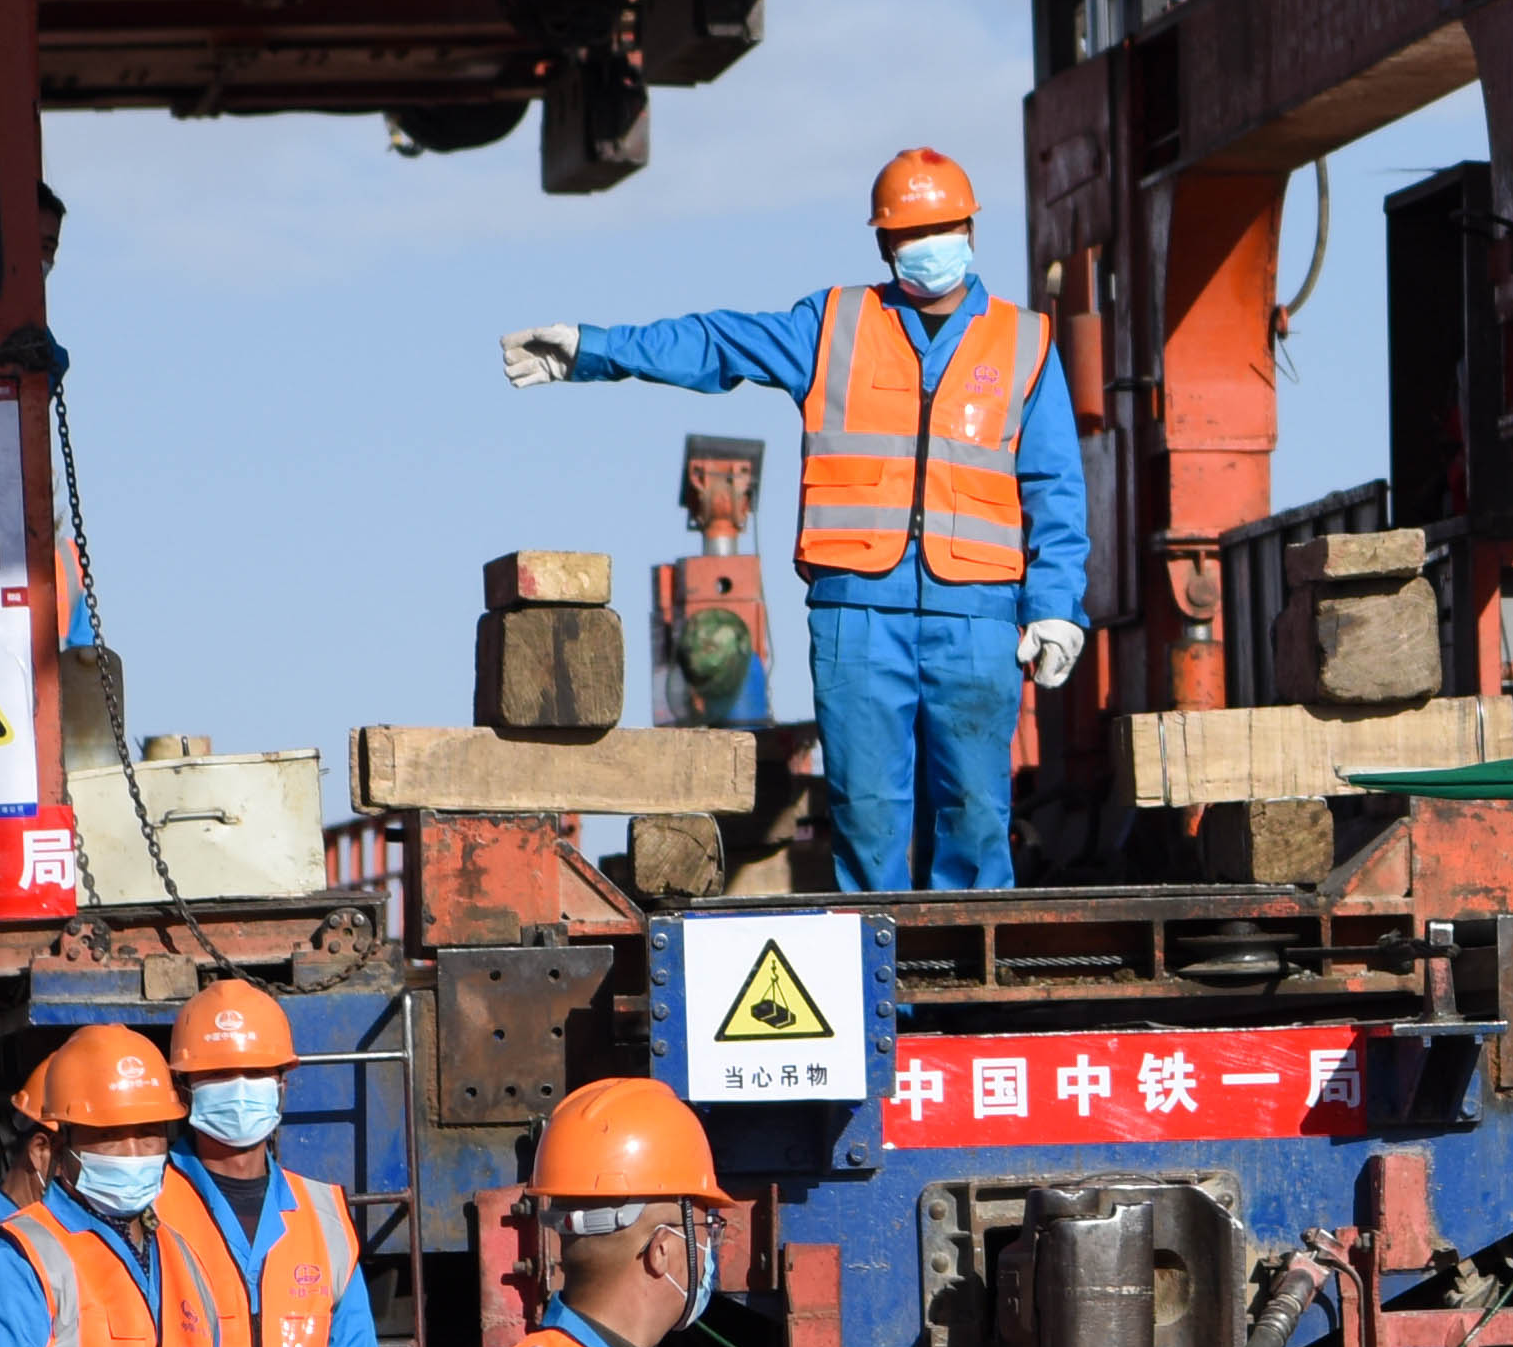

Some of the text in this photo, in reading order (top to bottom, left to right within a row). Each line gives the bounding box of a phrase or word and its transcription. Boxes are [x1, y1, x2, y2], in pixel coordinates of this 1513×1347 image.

[724, 1063, 828, 1090] 当心吊物
[890, 1051, 1361, 1120] 中国中铁一局
